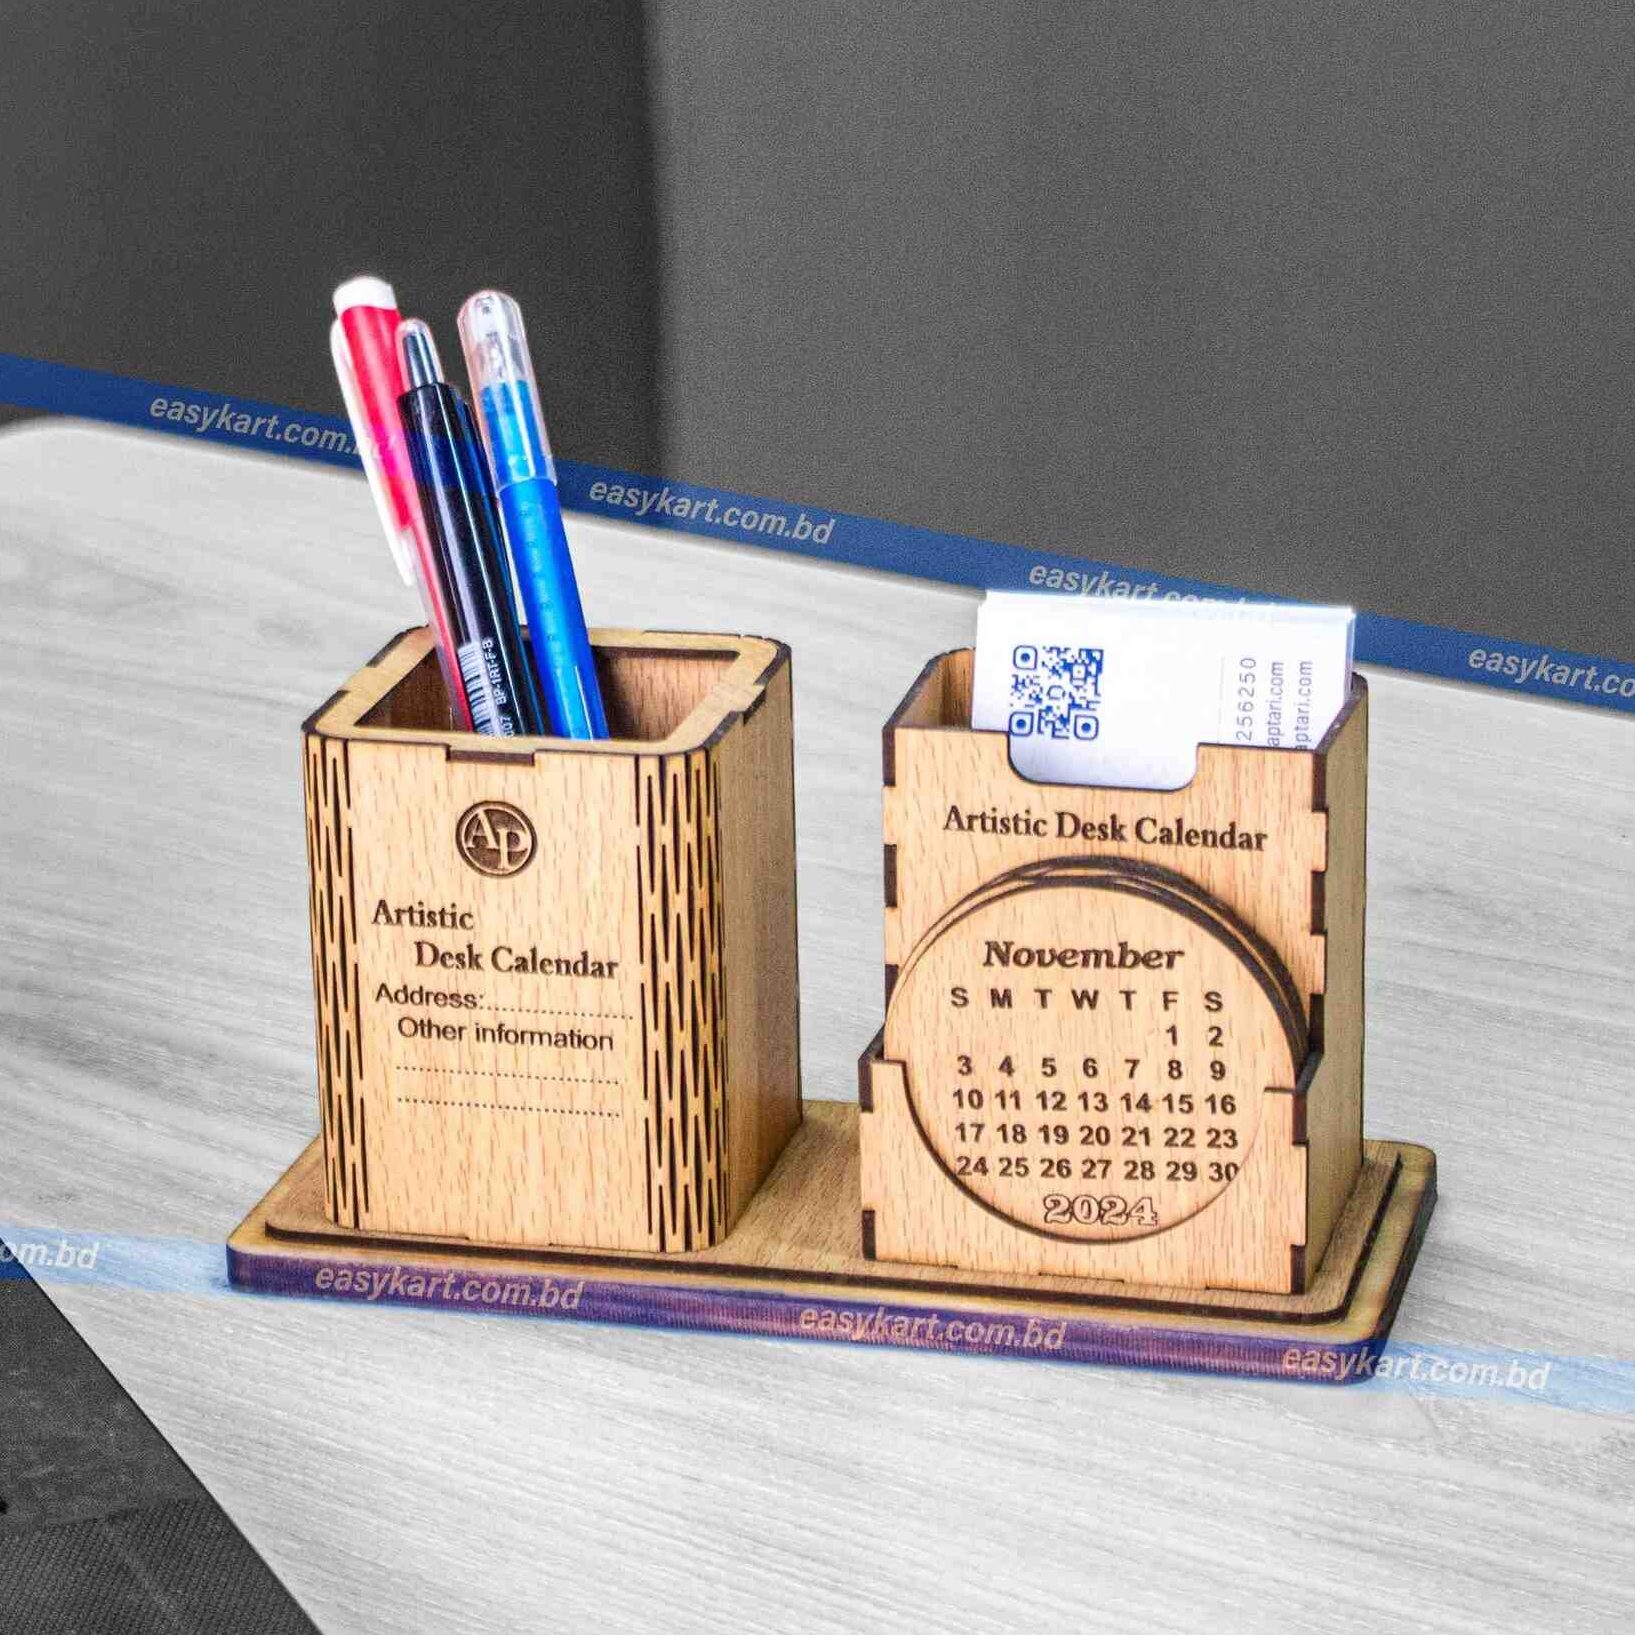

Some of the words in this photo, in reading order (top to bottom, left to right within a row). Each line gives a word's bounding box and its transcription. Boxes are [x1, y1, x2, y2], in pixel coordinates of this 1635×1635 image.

[1236, 657, 1257, 742] 256250
[942, 804, 1047, 837] Artistic
[1055, 811, 1128, 843] Desk
[1134, 814, 1268, 851] Calendar
[372, 898, 475, 930] Artistic
[414, 940, 484, 971] Desk
[490, 945, 619, 979] Calendar
[983, 940, 1185, 970] November
[950, 987, 970, 1008] S
[990, 989, 1013, 1009] M
[1034, 989, 1053, 1009] T
[1072, 990, 1099, 1010] W
[1119, 990, 1137, 1011] T
[1163, 991, 1179, 1011] F
[1204, 991, 1223, 1012] S
[398, 1016, 466, 1041] Other
[475, 1021, 614, 1051] information
[1166, 1025, 1178, 1046] 1
[1209, 1026, 1224, 1047] 2
[957, 1055, 973, 1076] 3
[999, 1056, 1016, 1077] 4
[1041, 1057, 1057, 1078] 5
[1082, 1058, 1099, 1078] 6
[1125, 1059, 1140, 1079] 7
[1168, 1059, 1183, 1080] 8
[1210, 1060, 1226, 1081] 9
[952, 1089, 984, 1110] 10
[995, 1090, 1022, 1110] 11
[1036, 1091, 1068, 1112] 12
[1077, 1092, 1109, 1113] 13
[1119, 1093, 1153, 1113] 14
[1161, 1094, 1194, 1114] 15
[1205, 1094, 1237, 1115] 16
[956, 1123, 985, 1143] 17
[996, 1123, 1027, 1144] 18
[1038, 1125, 1070, 1145] 19
[1079, 1125, 1111, 1146] 20
[1121, 1126, 1151, 1147] 21
[1163, 1127, 1195, 1148] 22
[1206, 1128, 1239, 1149] 23
[956, 1156, 989, 1177] 24
[999, 1157, 1030, 1178] 25
[1040, 1158, 1072, 1179] 26
[1081, 1159, 1112, 1180] 27
[1124, 1160, 1156, 1181] 28
[1166, 1161, 1198, 1182] 29
[1209, 1162, 1240, 1183] 30
[1043, 1194, 1159, 1226] 2024
